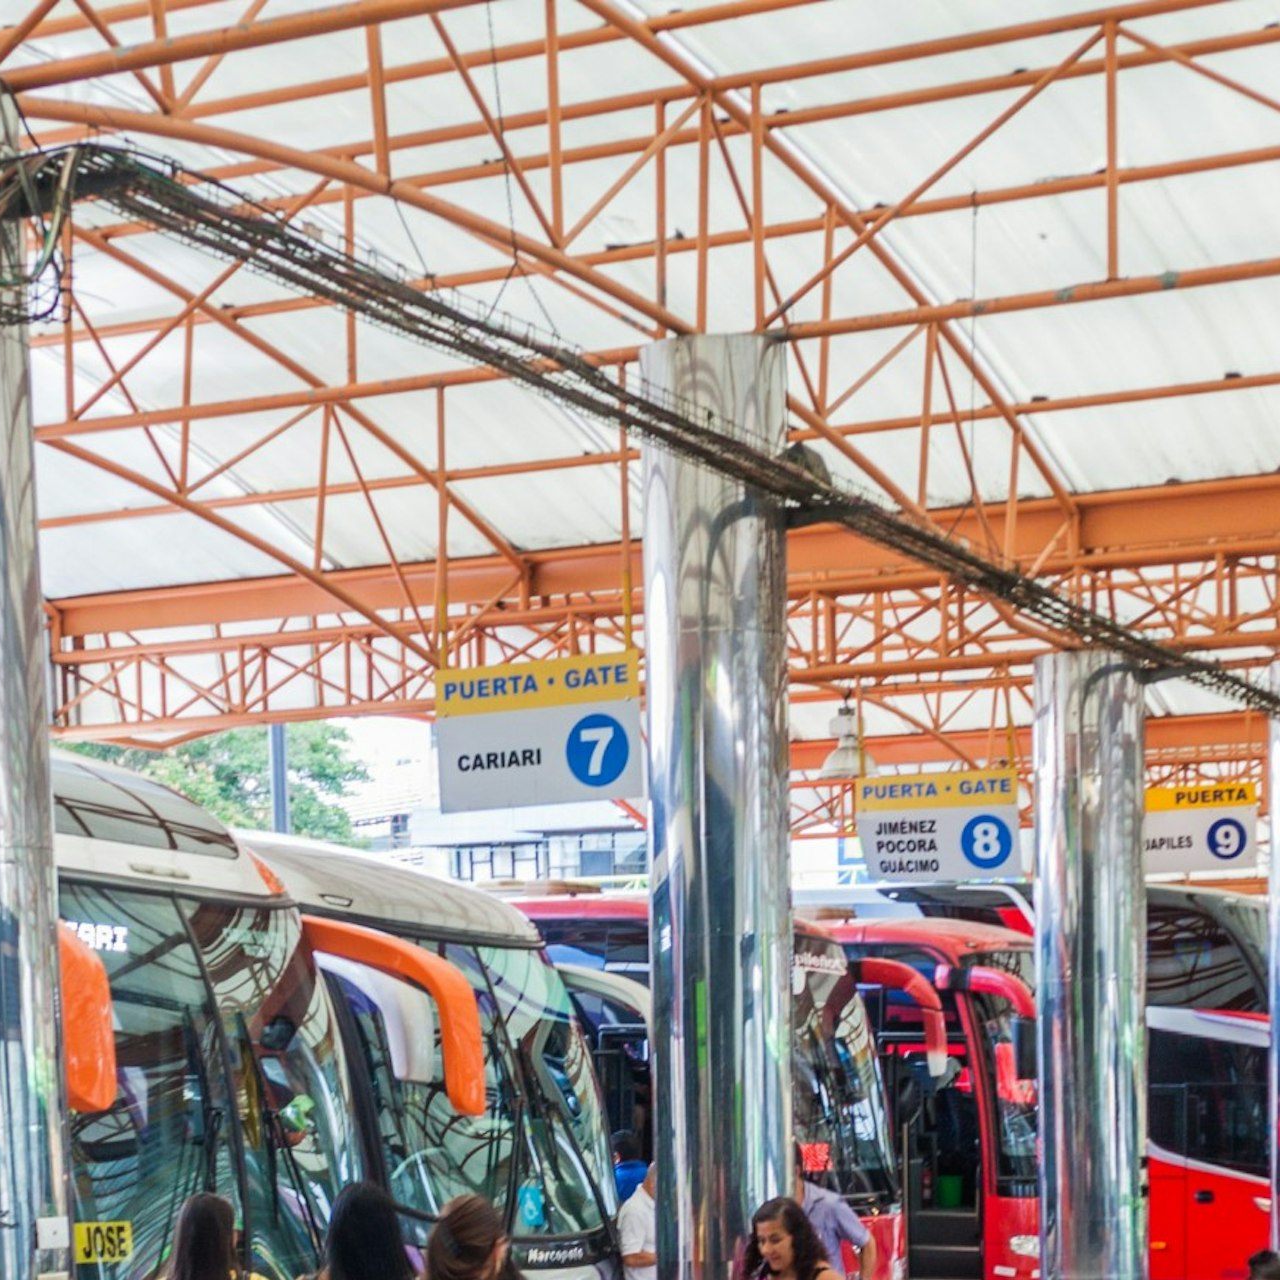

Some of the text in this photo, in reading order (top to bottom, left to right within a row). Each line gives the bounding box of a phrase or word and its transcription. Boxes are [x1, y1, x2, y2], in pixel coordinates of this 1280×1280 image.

[444, 664, 628, 701] PUERTA GATE
[457, 748, 542, 772] CARIARI
[580, 726, 614, 776] 7
[863, 778, 1012, 800] PUERTA GATE
[1175, 787, 1248, 805] PUERTA
[875, 817, 937, 836] JIMÉNEZ
[877, 839, 938, 854] POCORA
[972, 822, 1001, 860] 8
[1213, 822, 1241, 856] 9
[879, 857, 940, 874] GUÁCIMO
[83, 1226, 128, 1259] JOSE
[528, 1246, 584, 1264] Marcopolo
